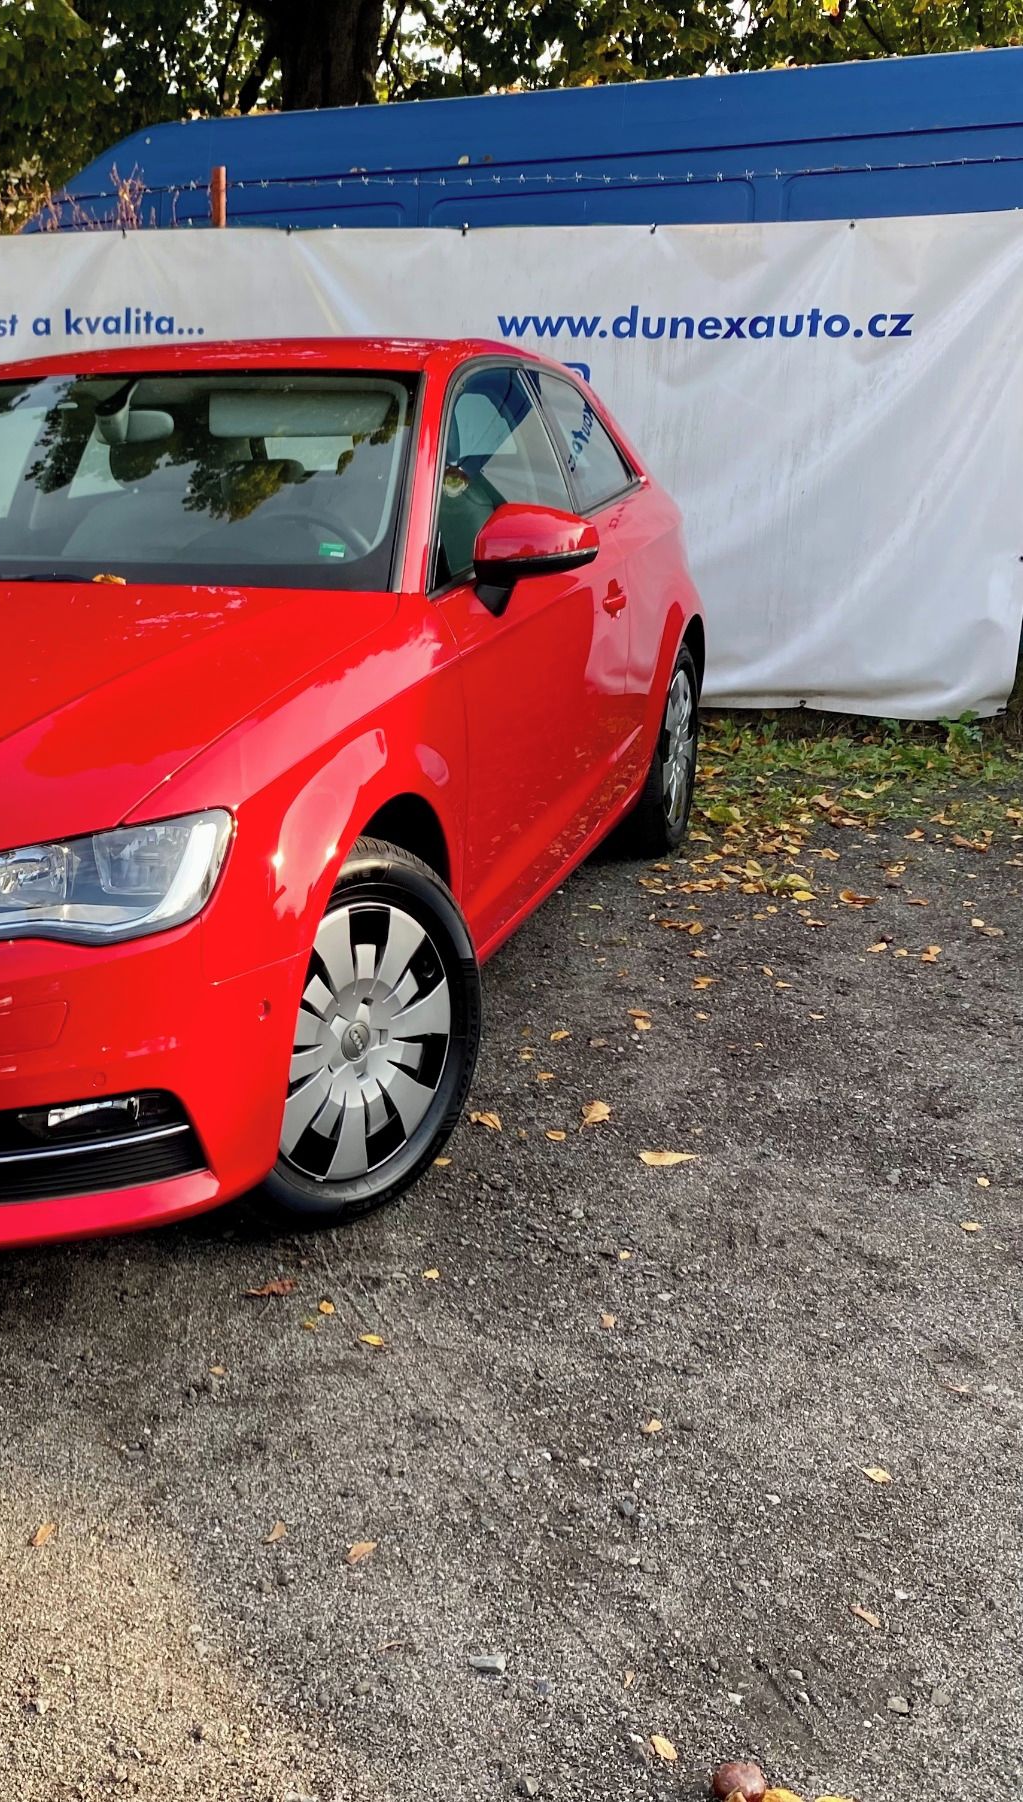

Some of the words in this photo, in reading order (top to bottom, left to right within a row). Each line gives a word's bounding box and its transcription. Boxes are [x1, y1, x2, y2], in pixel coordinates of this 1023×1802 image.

[32, 321, 52, 337] a
[64, 307, 206, 337] kvalita...
[497, 305, 914, 340] www.dunexauto.cz
